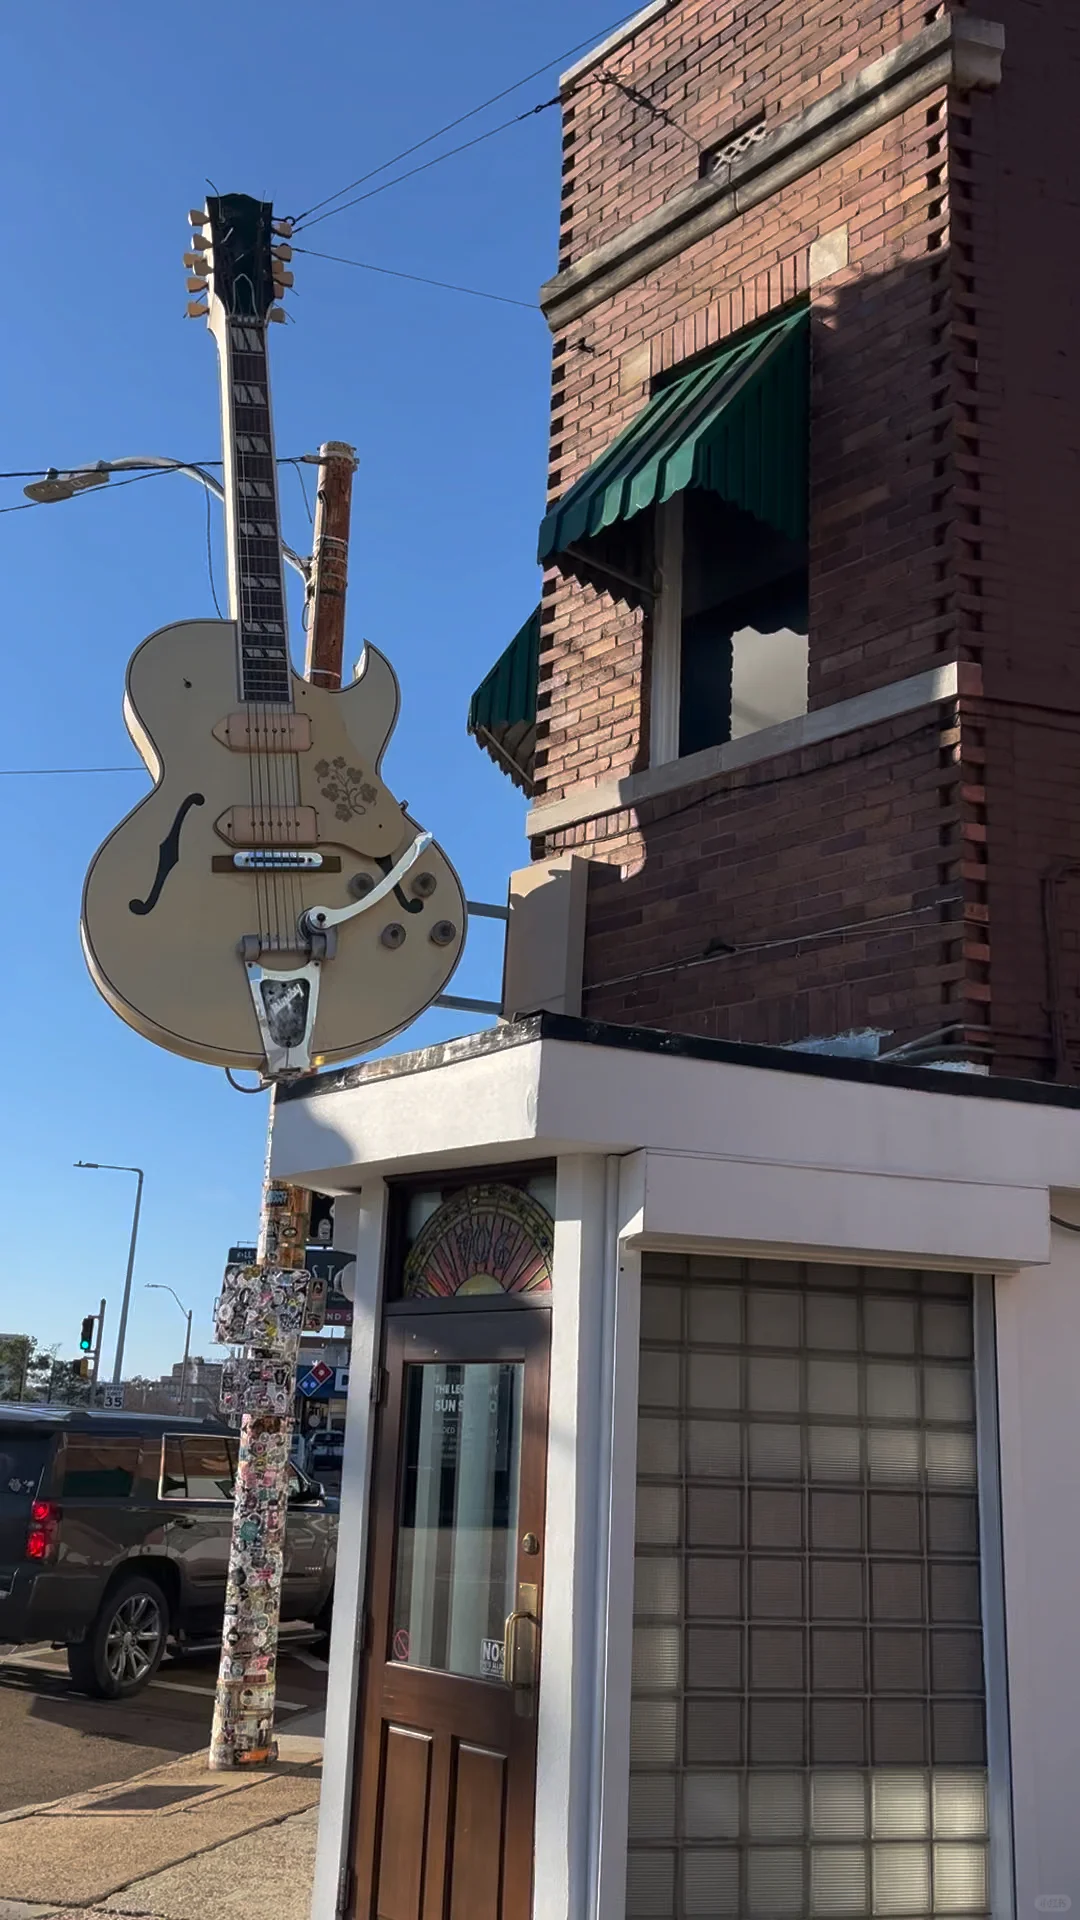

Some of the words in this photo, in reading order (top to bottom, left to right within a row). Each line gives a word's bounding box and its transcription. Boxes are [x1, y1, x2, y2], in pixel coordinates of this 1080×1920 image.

[434, 1384, 451, 1394] THE
[105, 1397, 122, 1407] 35
[434, 1399, 456, 1412] SUN
